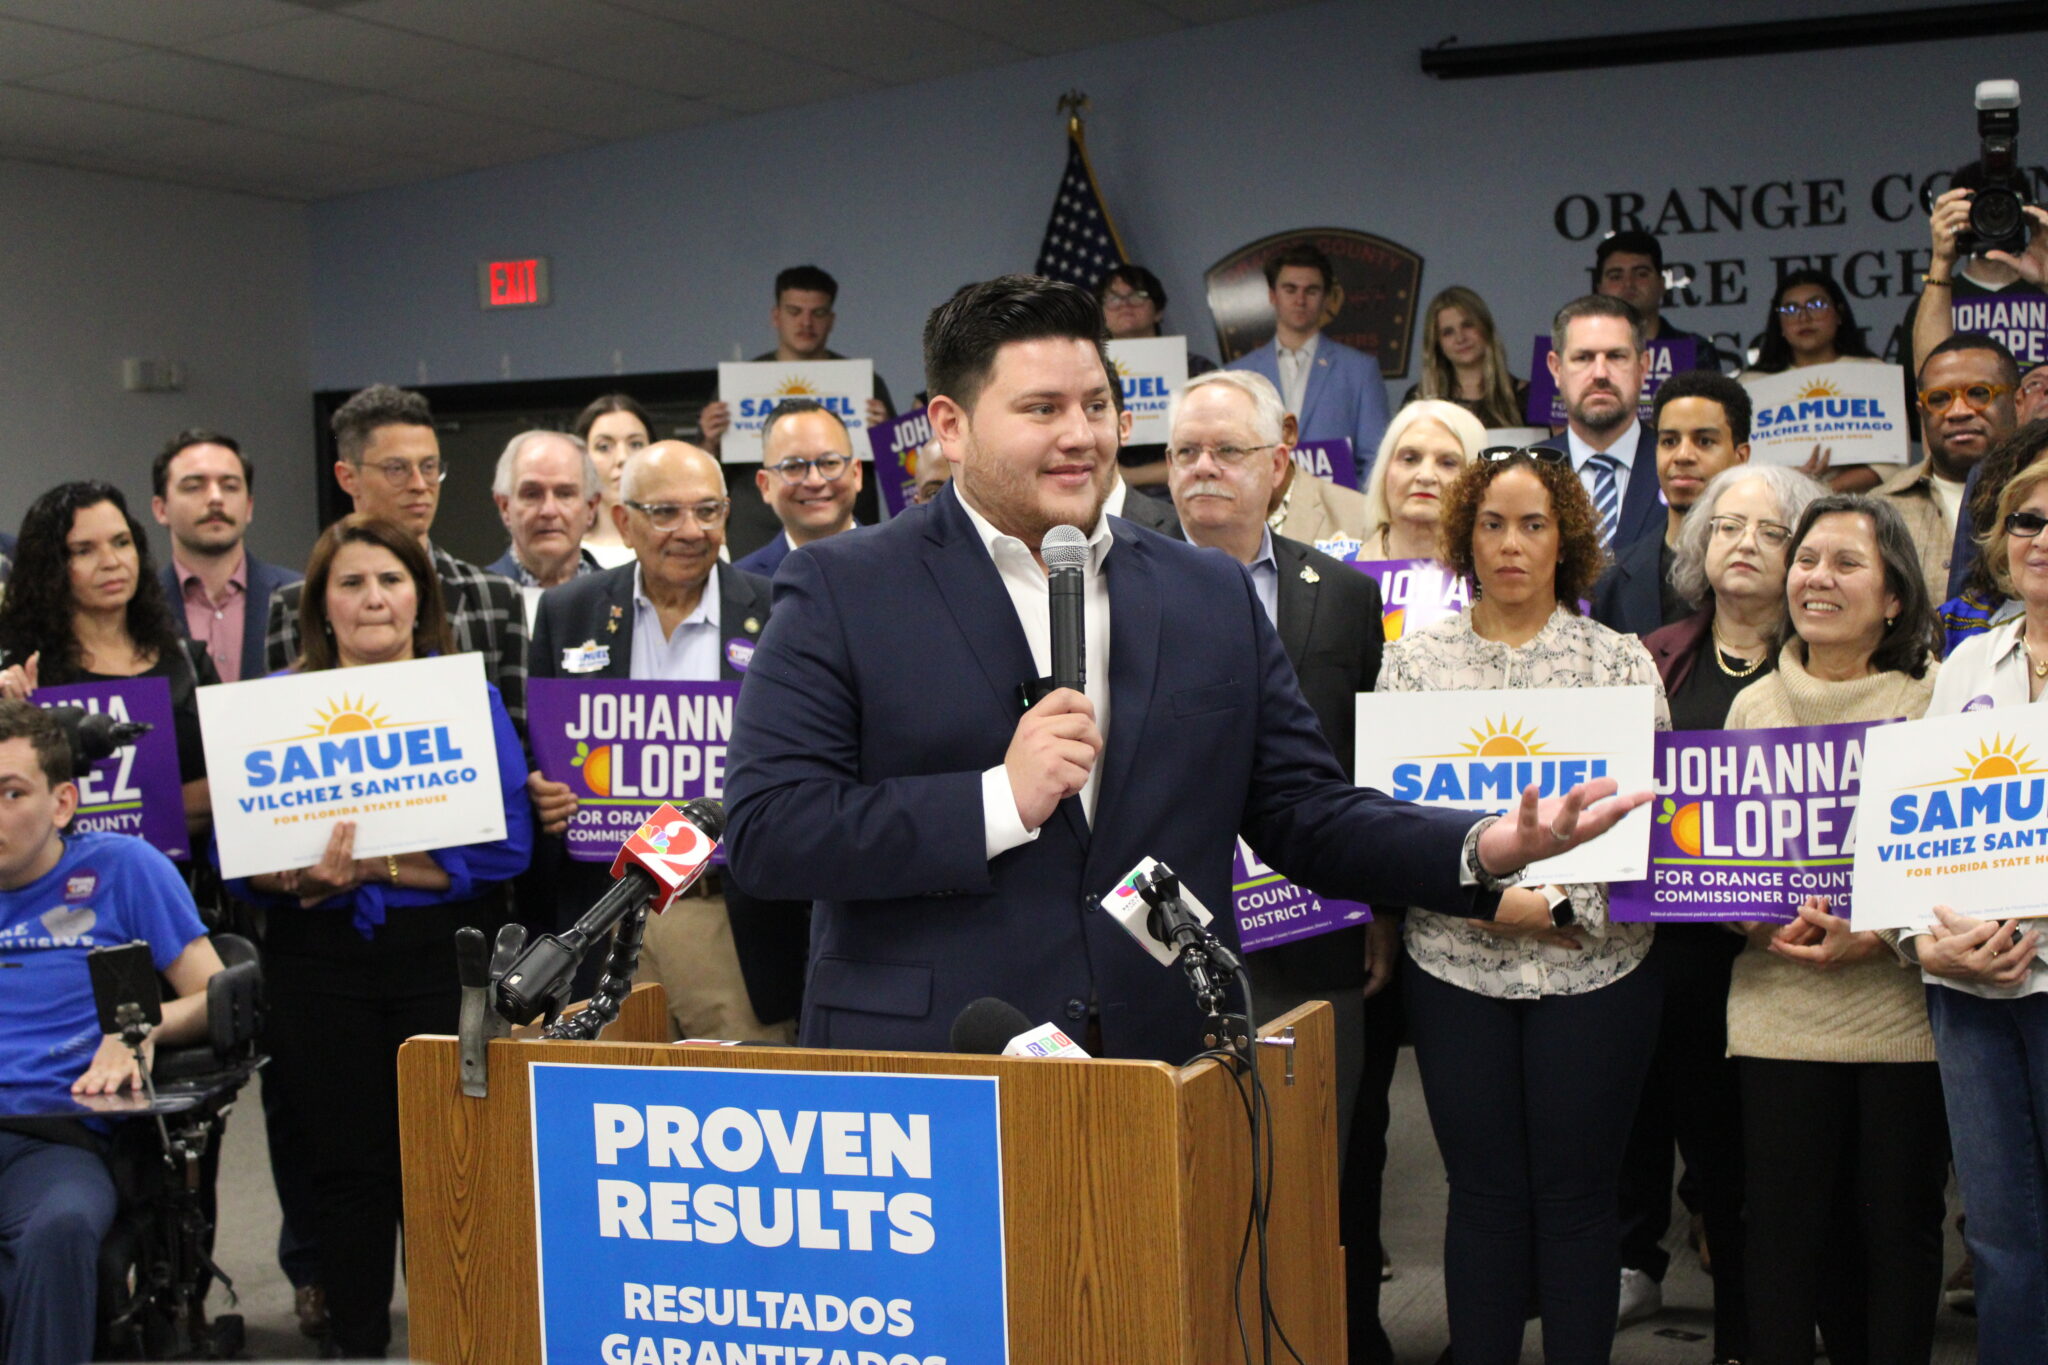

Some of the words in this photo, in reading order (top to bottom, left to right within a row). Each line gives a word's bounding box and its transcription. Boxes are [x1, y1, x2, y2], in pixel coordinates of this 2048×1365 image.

[1554, 178, 1846, 241] ORANGE
[490, 260, 537, 305] EXIT
[1952, 301, 2047, 331] OHANN
[1119, 376, 1170, 398] UEL
[1757, 398, 1885, 428] SAMUEL
[890, 414, 932, 453] JOH
[1751, 424, 1810, 441] VILCHEZ
[1814, 422, 1893, 433] SANTIAGO
[565, 694, 733, 741] JOHANN
[244, 726, 463, 787] SAMUEL
[612, 744, 728, 798] LOPE
[1653, 739, 1862, 796] JOHANNA
[238, 784, 343, 813] VILCHEZ
[351, 767, 477, 797] SANTIAGO
[273, 813, 299, 825] FOR
[304, 805, 359, 821] FLORIDA
[363, 799, 401, 814] STATE
[406, 794, 448, 808] HOUSE
[1890, 778, 2048, 835] SAMU
[74, 813, 143, 834] OUNTY
[1878, 835, 1976, 862] VILCHEZ
[1654, 870, 1694, 885] FOR
[1700, 871, 1784, 887] ORANGE
[1789, 871, 1853, 889] COUNT
[1906, 868, 1932, 878] FOR
[1936, 861, 1988, 875] FLORIDA
[1993, 855, 2031, 868] STATE
[1237, 884, 1312, 912] COUNT
[1654, 890, 1783, 903] COMMISSIONER
[1788, 892, 1852, 907] DITRIC
[1241, 905, 1307, 931] DISTRICT
[1311, 900, 1322, 913] 4
[593, 1102, 932, 1179] PROVEN
[597, 1178, 936, 1255] RESULTS
[623, 1281, 915, 1337] RESULTADOS
[601, 1334, 947, 1365] GARANTI
